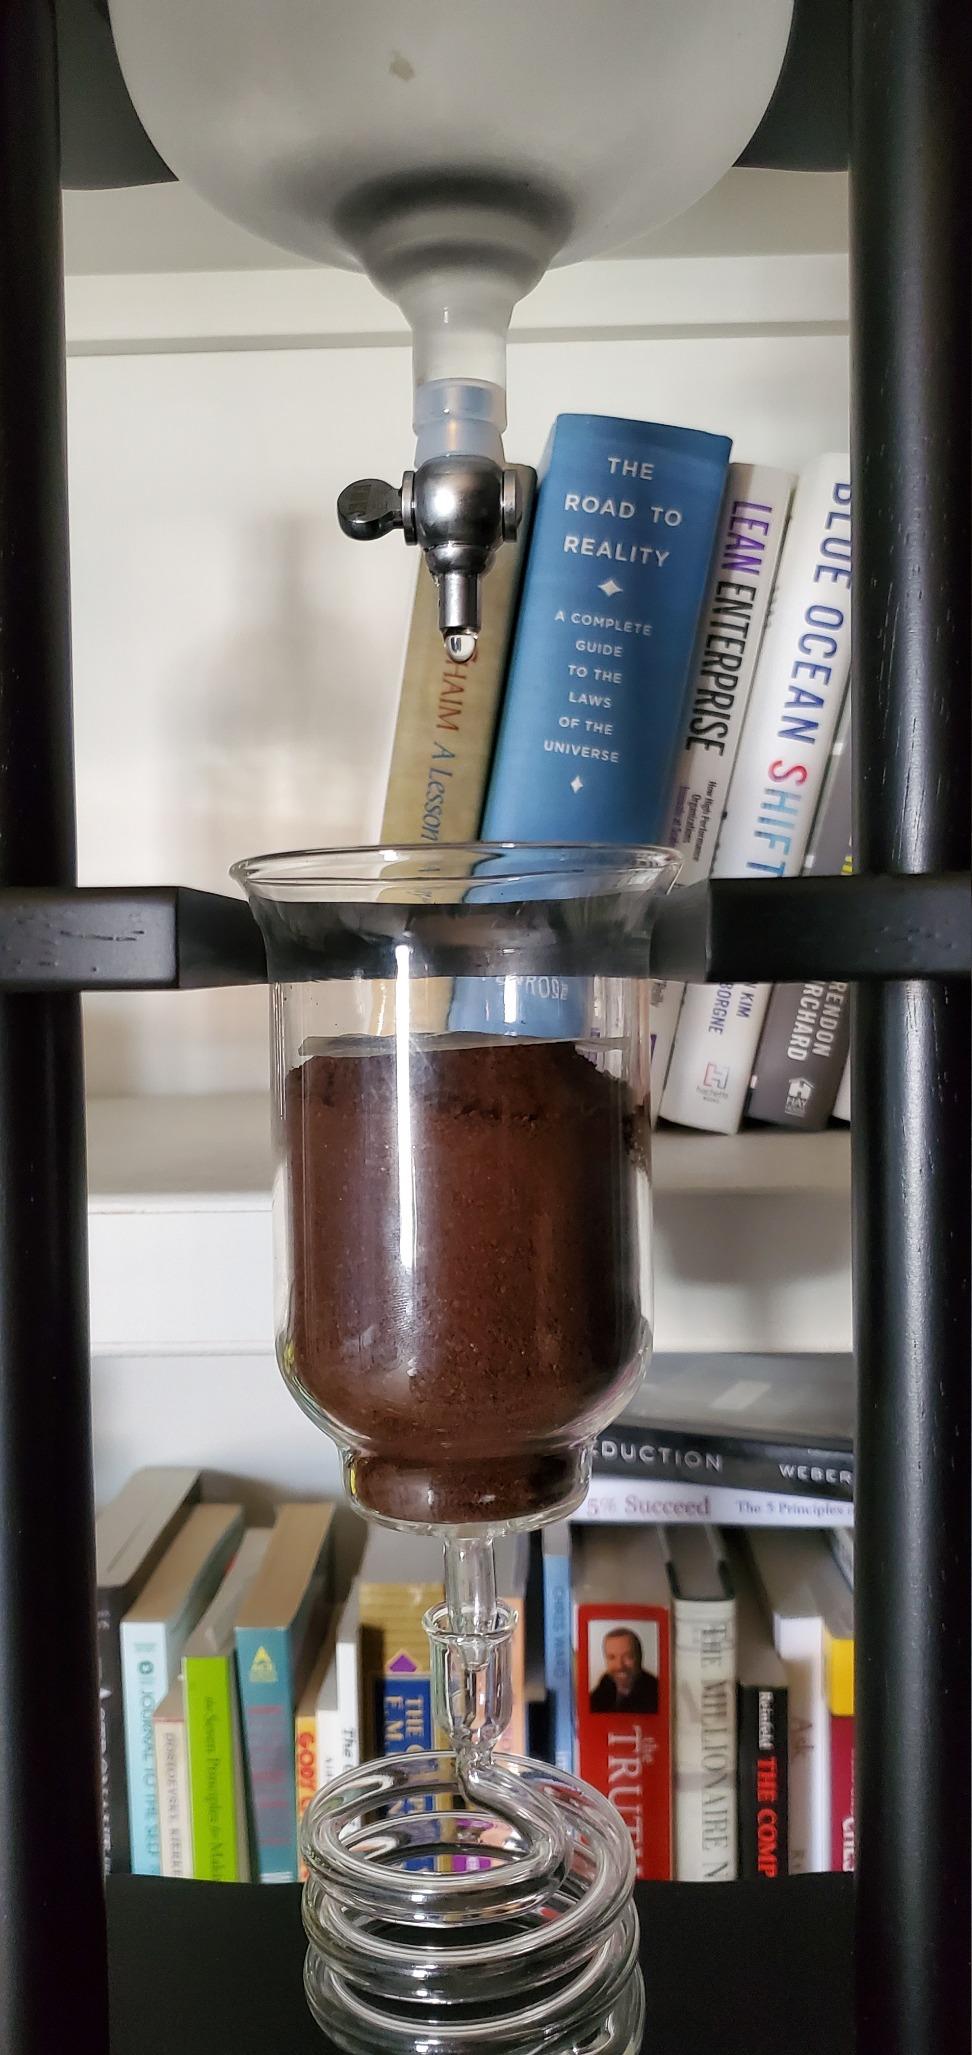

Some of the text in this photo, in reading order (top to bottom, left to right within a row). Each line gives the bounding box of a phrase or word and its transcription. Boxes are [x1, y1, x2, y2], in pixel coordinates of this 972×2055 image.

[608, 457, 655, 480] THE
[564, 494, 682, 527] ROAD TO
[563, 535, 670, 567] REALITY
[554, 610, 653, 636] A COMPLETE
[685, 500, 772, 757] LEAN ENTERPRISE
[575, 640, 623, 657] GUIDE
[568, 665, 623, 684] TO THE
[777, 604, 844, 745] OCEAN
[569, 692, 612, 709] LAWS
[558, 716, 613, 735] OF THE
[421, 654, 478, 841] HAIM A Lesson
[544, 740, 620, 763] UNIVERSE
[746, 760, 808, 877] SHIFT
[708, 982, 733, 1035] BORGNE
[736, 991, 755, 1019] KIM
[787, 981, 826, 1061] RCHARD
[779, 1464, 853, 1485] WEBER
[625, 1494, 711, 1516] Succeed
[703, 1624, 727, 1668] THE
[404, 1695, 424, 1737] THE
[703, 1679, 728, 1851] MILLIONAIRE
[607, 1724, 645, 1878] TRUT
[757, 1756, 778, 1879] THE COMP
